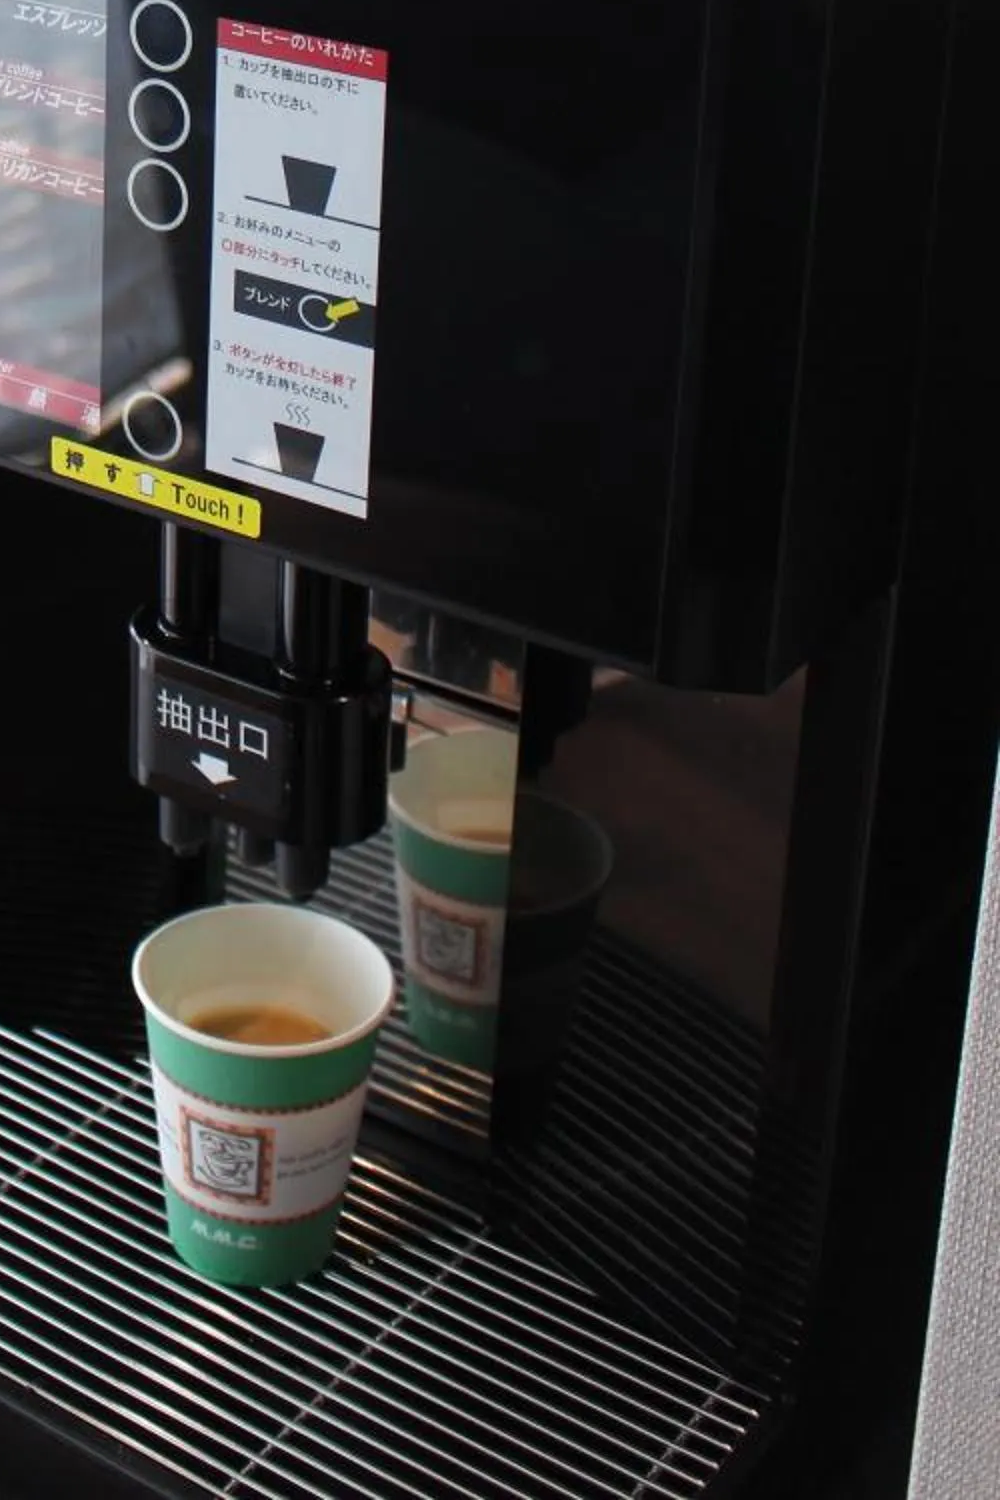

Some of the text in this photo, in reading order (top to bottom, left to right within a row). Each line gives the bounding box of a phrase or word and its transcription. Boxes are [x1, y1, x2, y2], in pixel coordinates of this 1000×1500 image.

[231, 23, 374, 66] コーヒーのいれかた
[244, 286, 291, 312] ブレンド
[157, 688, 268, 760] 抽出口
